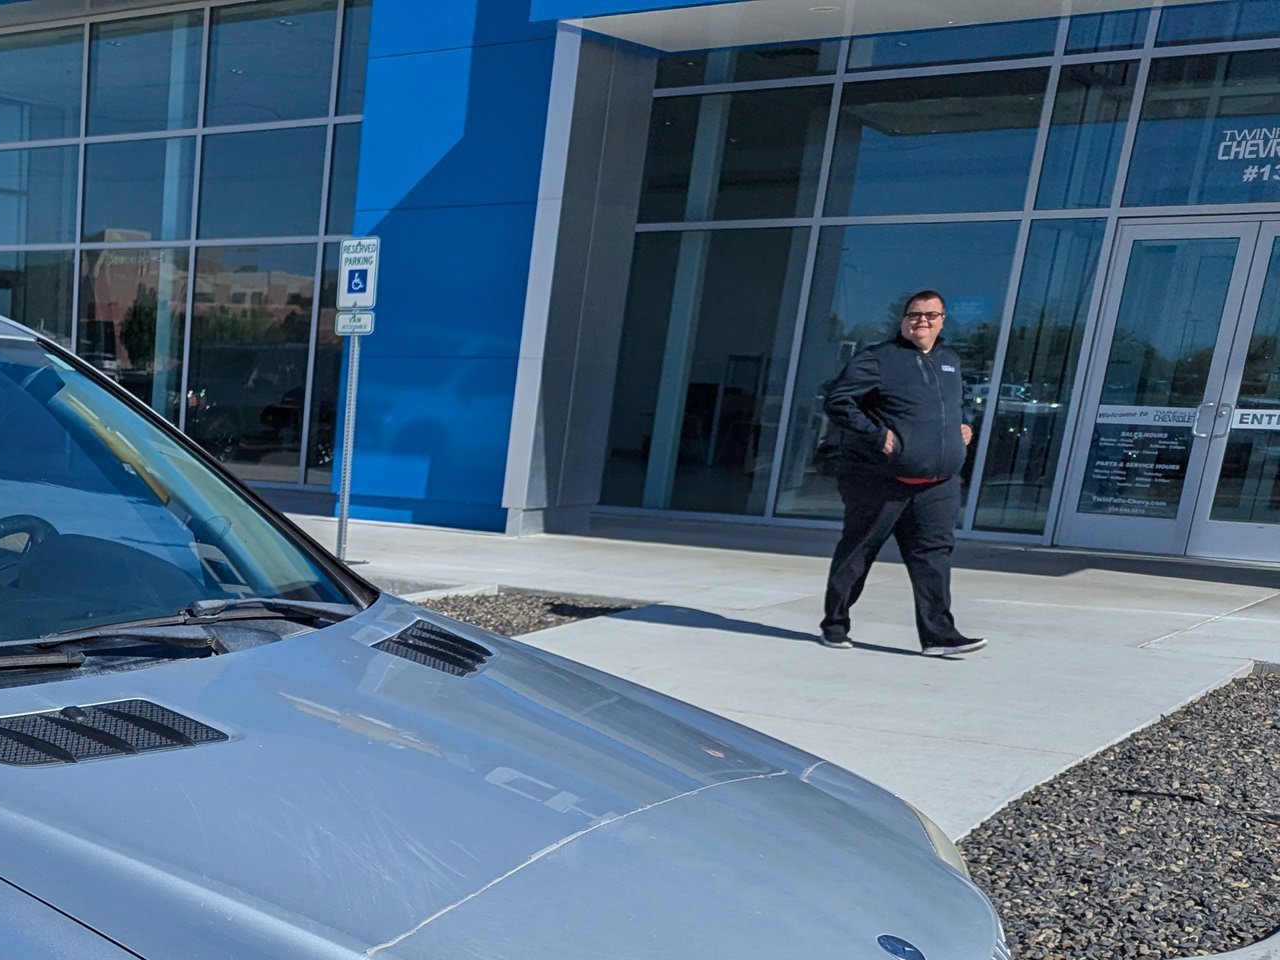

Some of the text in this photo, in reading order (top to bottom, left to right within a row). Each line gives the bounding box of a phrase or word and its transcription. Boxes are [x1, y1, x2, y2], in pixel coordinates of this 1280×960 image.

[343, 243, 376, 255] RESERVED
[344, 256, 374, 267] PARKING
[348, 316, 362, 324] VAN
[1139, 410, 1149, 418] to
[1238, 413, 1280, 425] ENT
